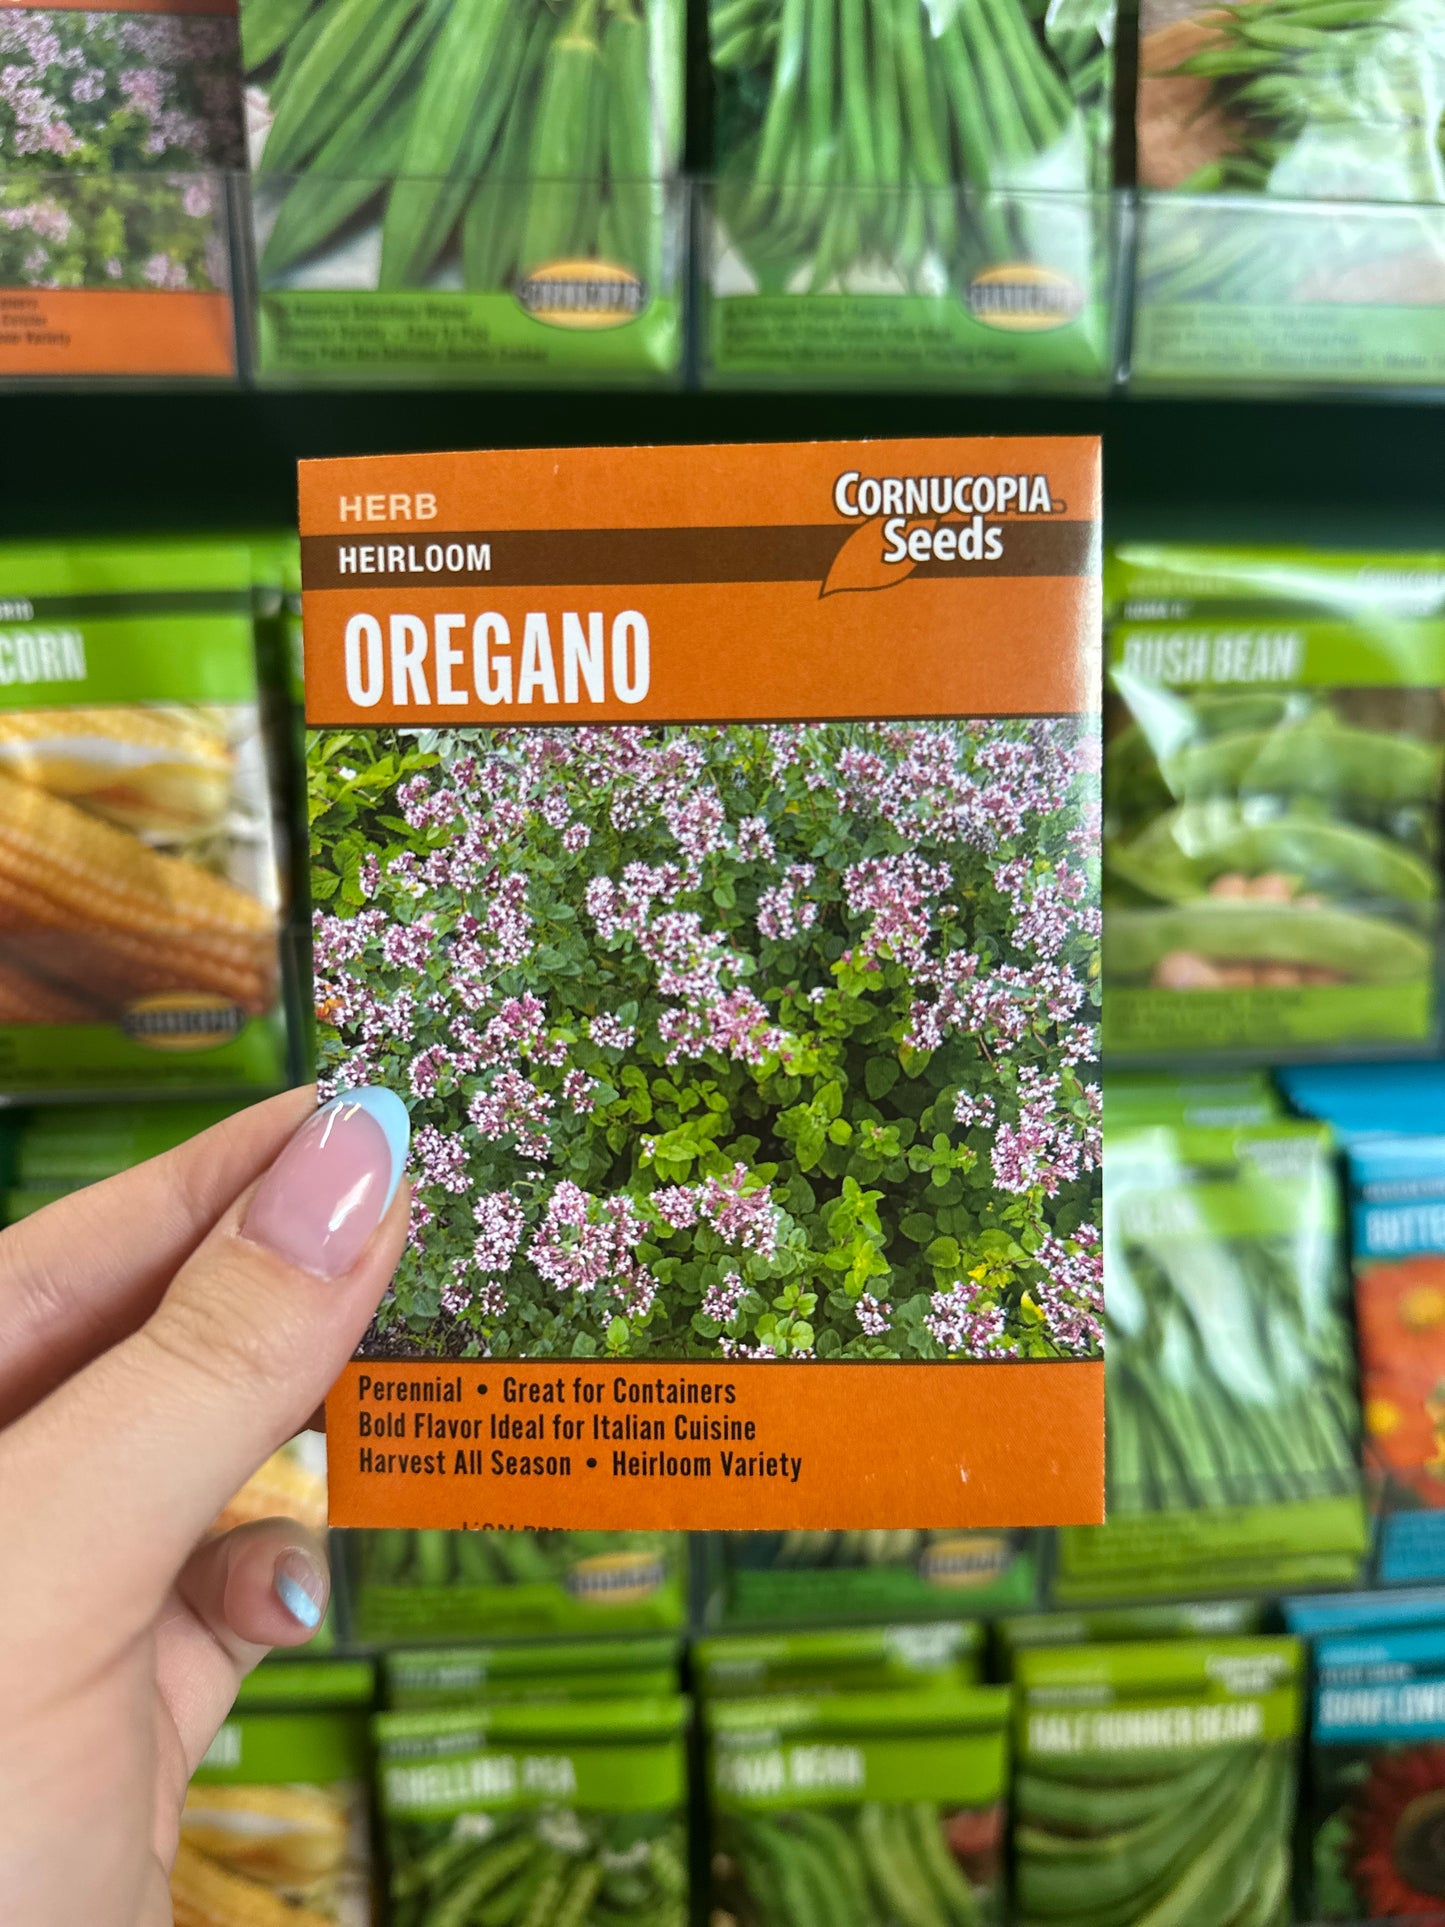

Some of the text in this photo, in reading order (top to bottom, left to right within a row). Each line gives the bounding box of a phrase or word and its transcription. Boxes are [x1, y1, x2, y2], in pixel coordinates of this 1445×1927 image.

[339, 493, 438, 522] HERB
[834, 470, 1052, 517] CORNUCOPIA
[883, 515, 1005, 563] Seeds
[338, 544, 492, 574] HEIRLOOM
[344, 610, 651, 708] OREGANO
[359, 1375, 736, 1404] Perennial Great for Containers
[359, 1411, 756, 1441] Bold Flavor Ideal for Italian Cuisine
[359, 1447, 802, 1483] Harvest All Season Heirloom Variety
